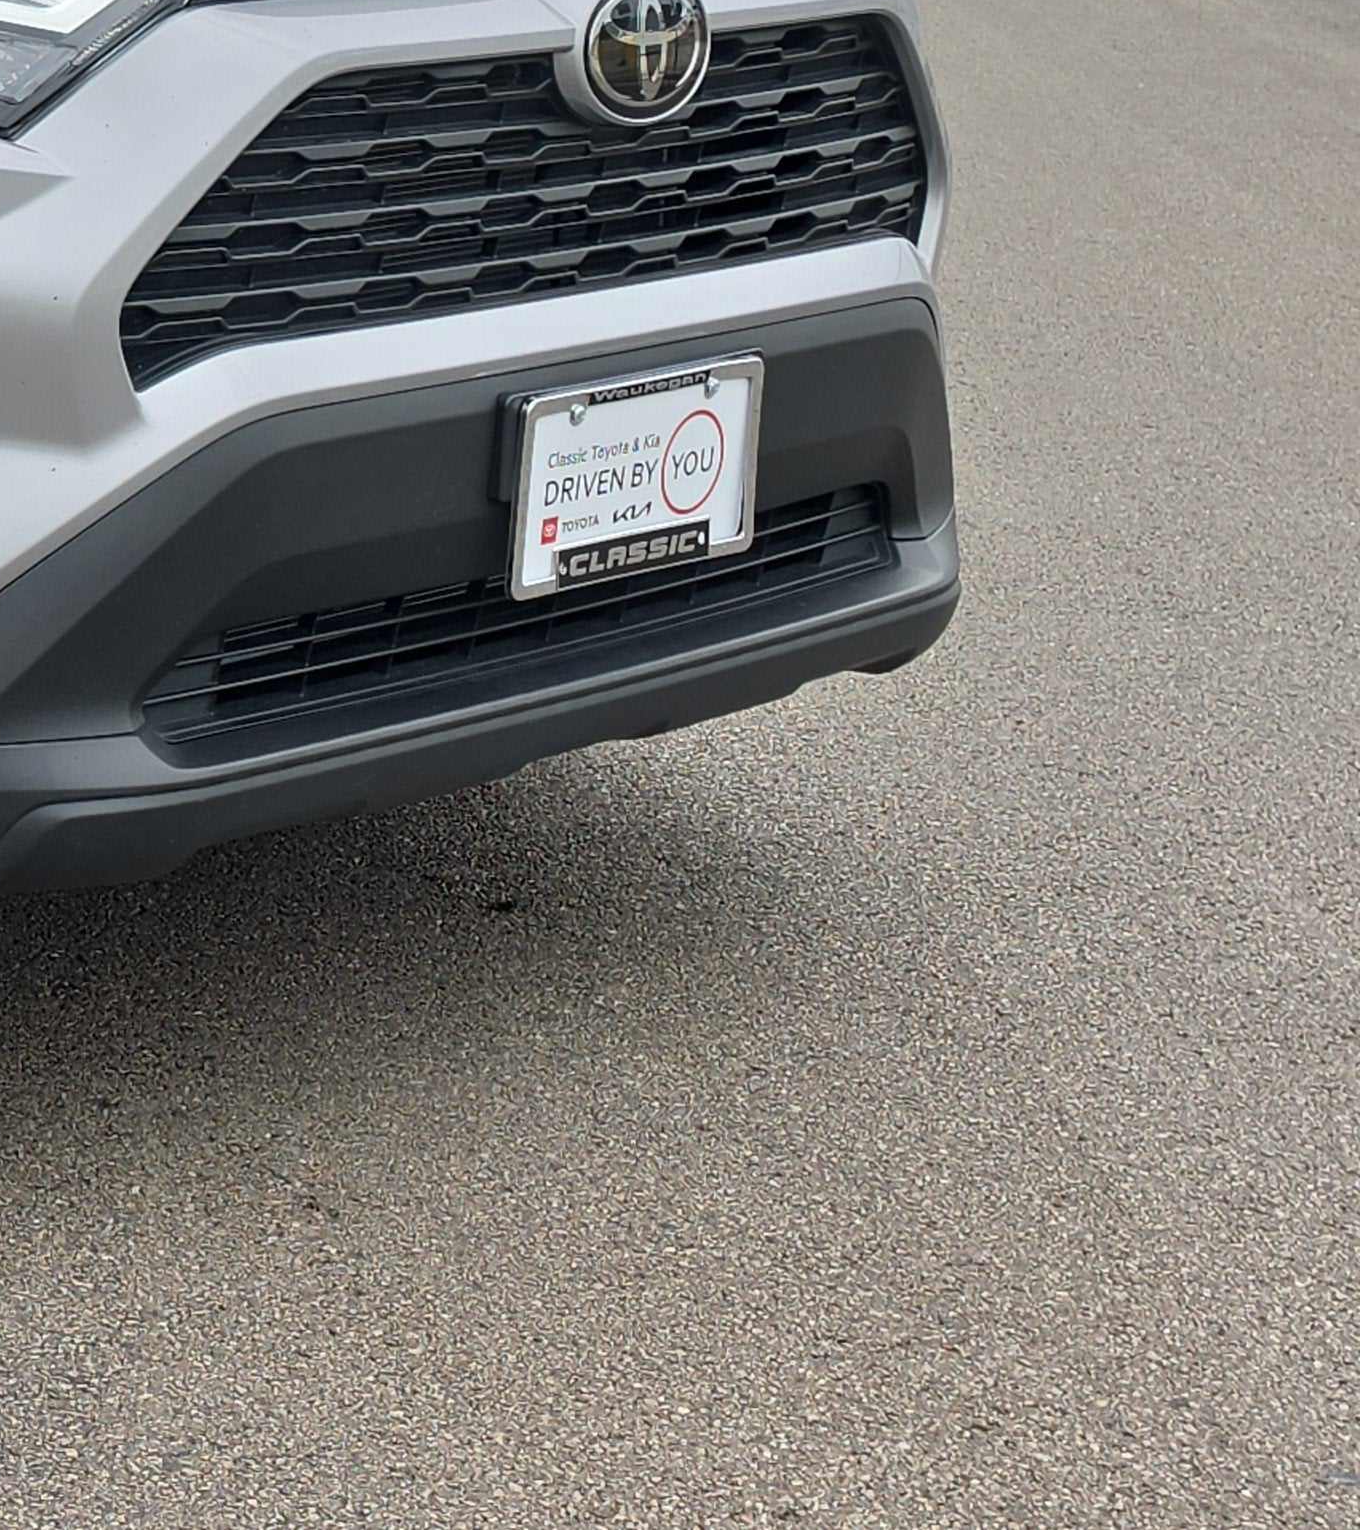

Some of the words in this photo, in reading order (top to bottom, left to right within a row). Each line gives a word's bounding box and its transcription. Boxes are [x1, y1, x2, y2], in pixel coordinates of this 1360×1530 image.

[593, 372, 707, 403] Waukegan
[548, 447, 588, 468] Classic
[591, 442, 629, 462] Toyota
[632, 437, 640, 453] &
[643, 433, 660, 451] Kia
[544, 466, 626, 507] DRIVEN
[631, 458, 659, 488] BY
[672, 446, 715, 480] YOU
[561, 514, 600, 534] TOYOTA
[569, 530, 698, 578] CLASSIC
